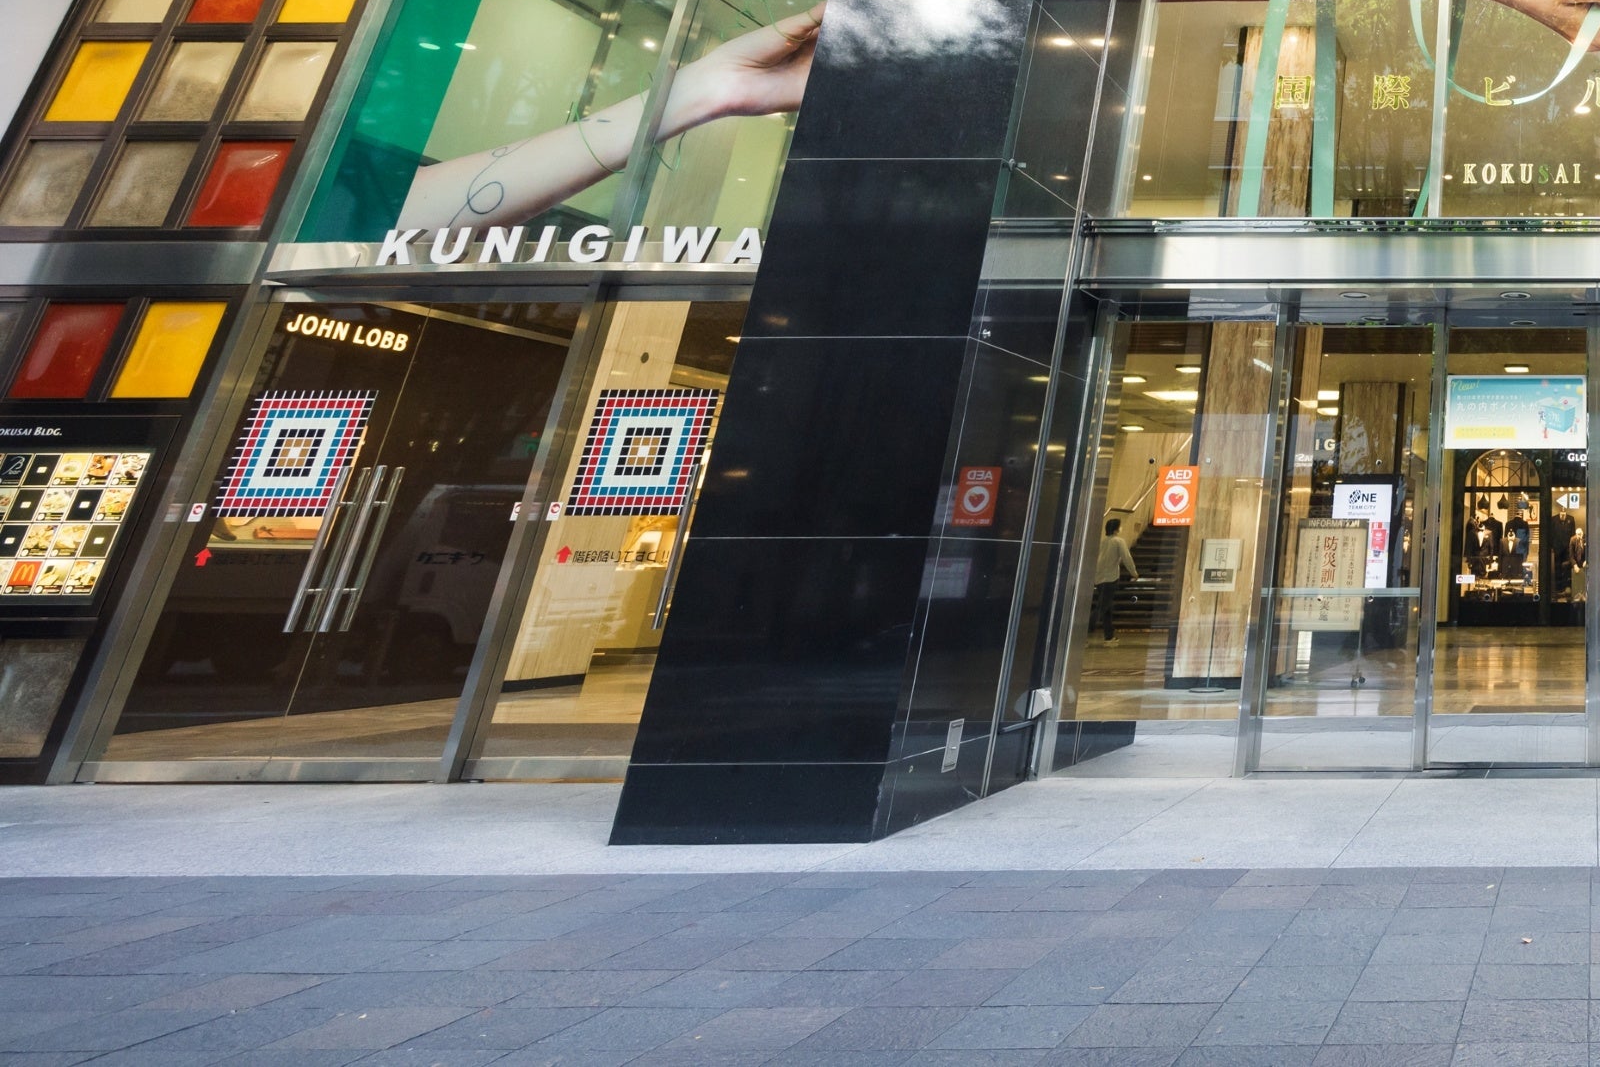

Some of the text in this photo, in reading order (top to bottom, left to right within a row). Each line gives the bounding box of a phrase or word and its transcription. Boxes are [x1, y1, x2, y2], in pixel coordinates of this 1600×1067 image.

[1463, 162, 1582, 185] KOKUSAI
[376, 225, 763, 266] KUNIGIWA
[286, 313, 409, 352] JOHN LOBB
[34, 427, 63, 436] BLDG.
[1166, 469, 1192, 480] AED
